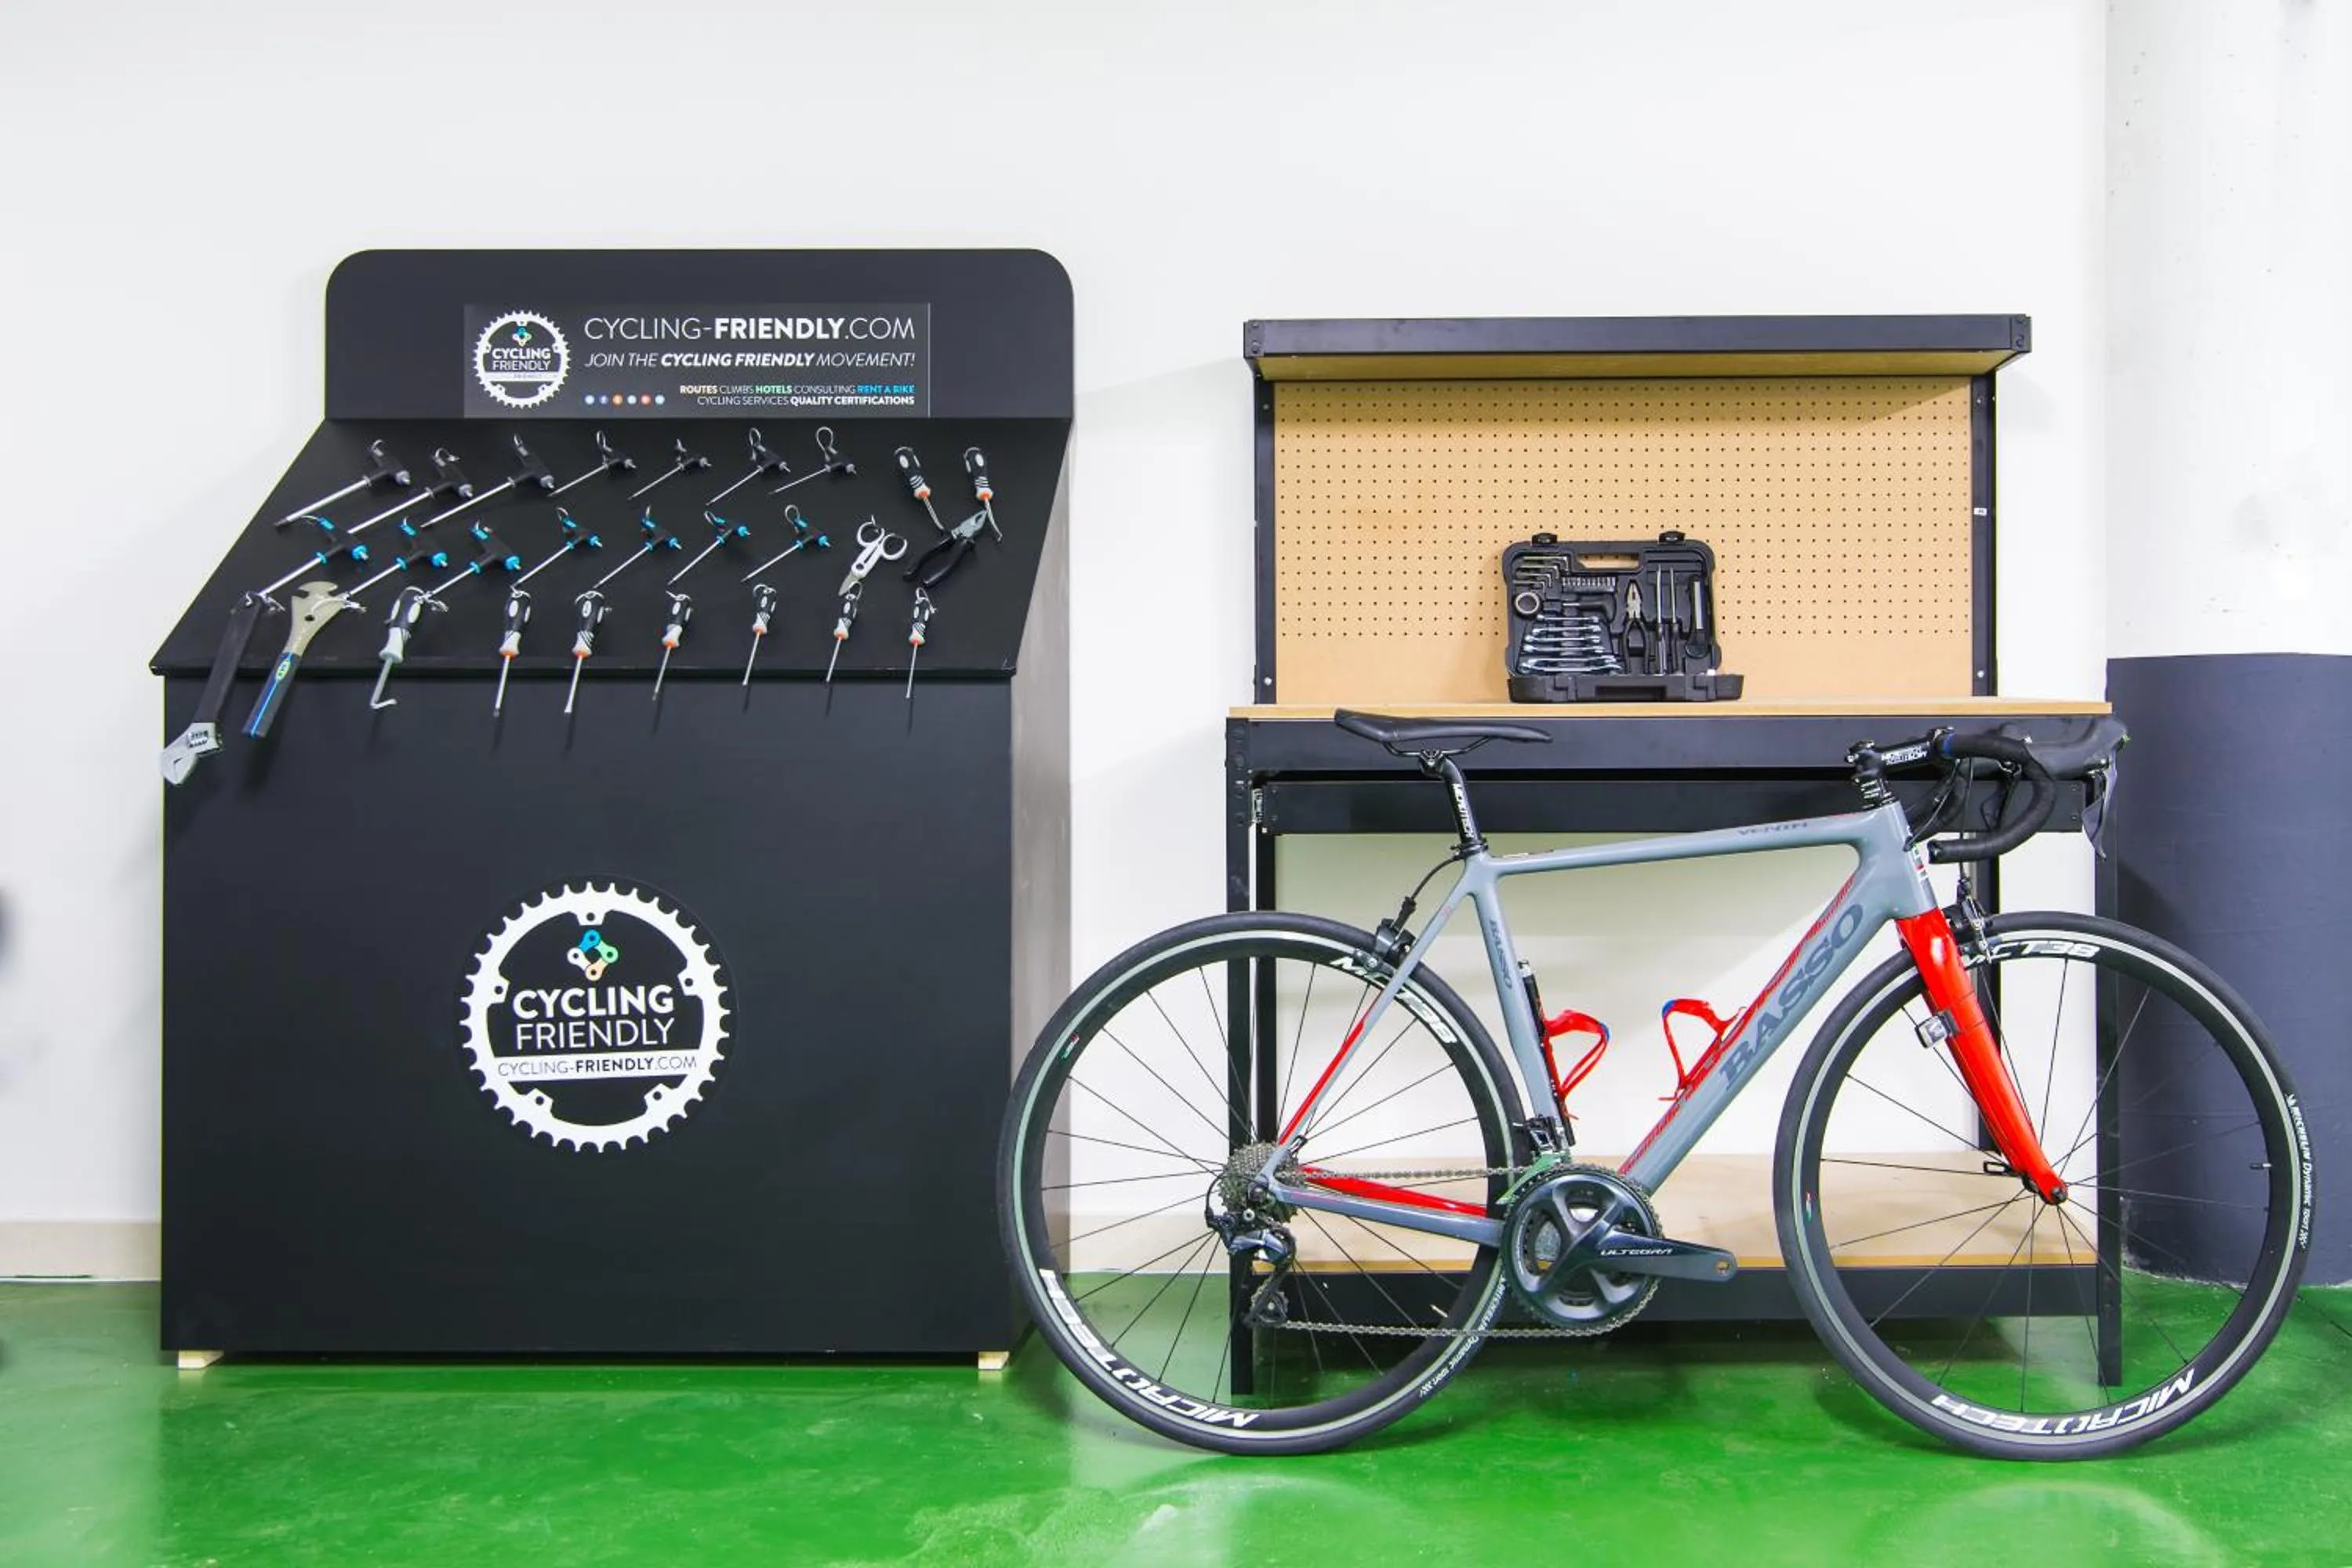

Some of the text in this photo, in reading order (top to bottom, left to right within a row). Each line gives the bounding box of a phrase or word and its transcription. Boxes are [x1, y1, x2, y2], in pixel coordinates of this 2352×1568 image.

[584, 318, 916, 339] CYCLING-FRIENDLY.COM
[492, 348, 551, 360] CYCLING
[584, 353, 916, 367] JOIN THE CYCLING FRIENDLY MOVEMENT!
[492, 361, 551, 371] FRIENDLY
[680, 385, 915, 394] ROUTES CLIMBS HOTELS CONSULTING RENT A BIKE
[697, 396, 915, 406] CYCLING SERVICES QUALITY CERTIFICATIONS
[513, 984, 673, 1019] CYCLING
[1719, 903, 1864, 1091] BASSO
[516, 1018, 674, 1051] FRIENDLY
[498, 1055, 697, 1076] CYCLING-FRIENDLY.COM
